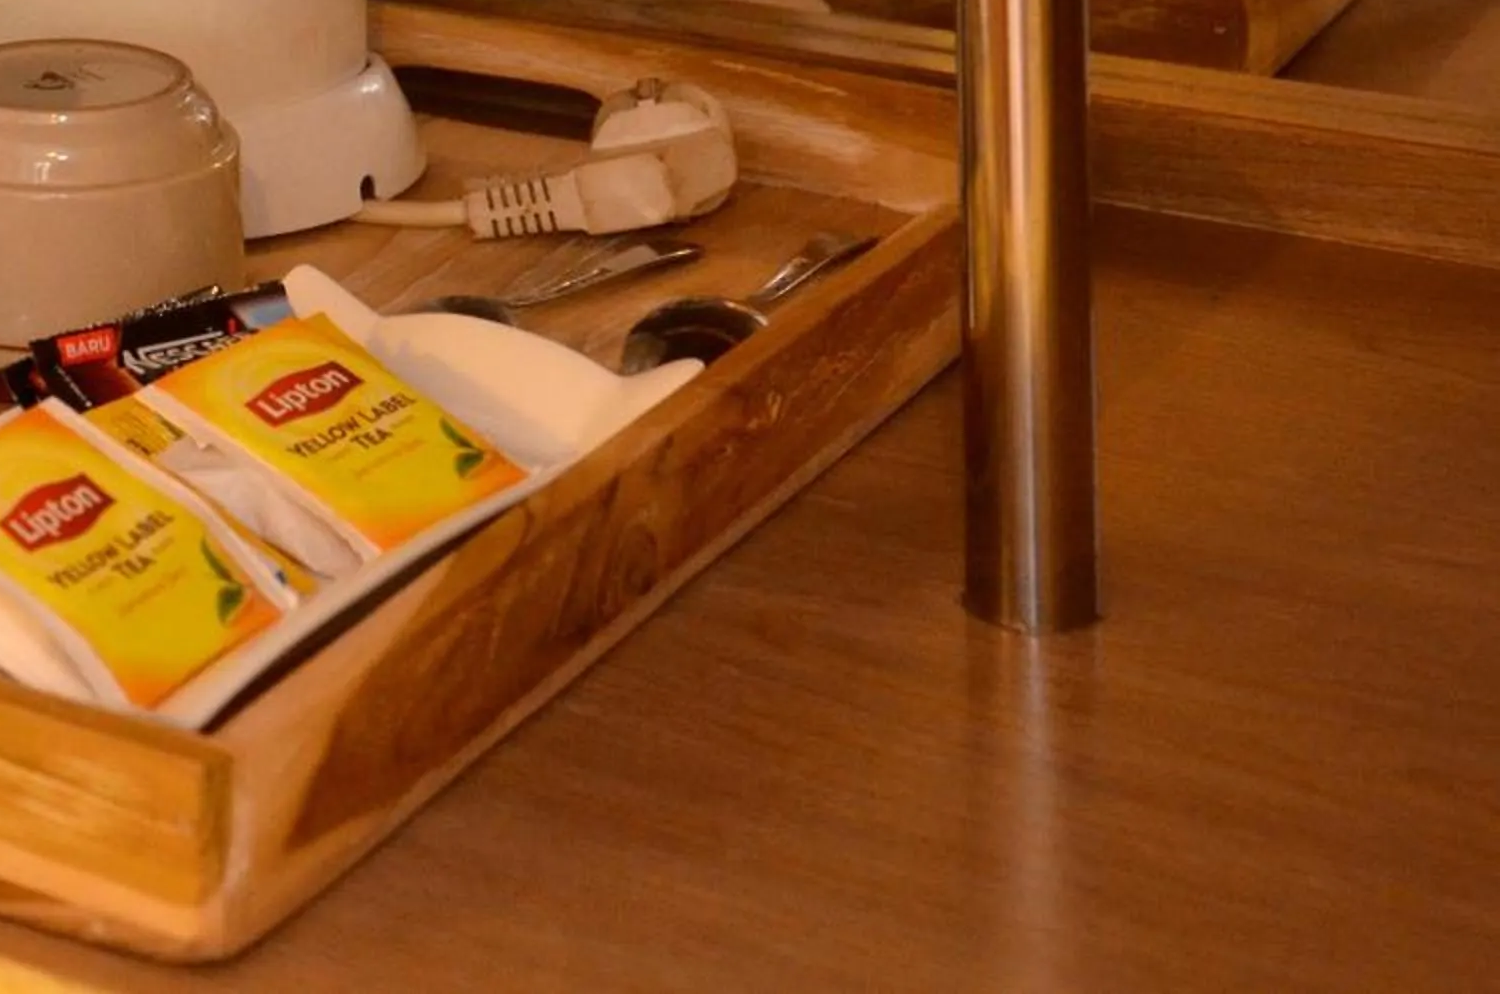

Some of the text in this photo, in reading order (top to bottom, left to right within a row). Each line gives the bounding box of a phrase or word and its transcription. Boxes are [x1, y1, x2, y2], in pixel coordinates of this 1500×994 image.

[64, 333, 112, 359] BARU
[255, 368, 350, 419] Lipton
[286, 415, 360, 459] YELLOW
[356, 390, 418, 424] LABEL
[349, 426, 393, 450] TEA
[8, 484, 104, 545] Lipton
[48, 509, 175, 590] YELLOW LABEL
[110, 555, 157, 580] TEA
